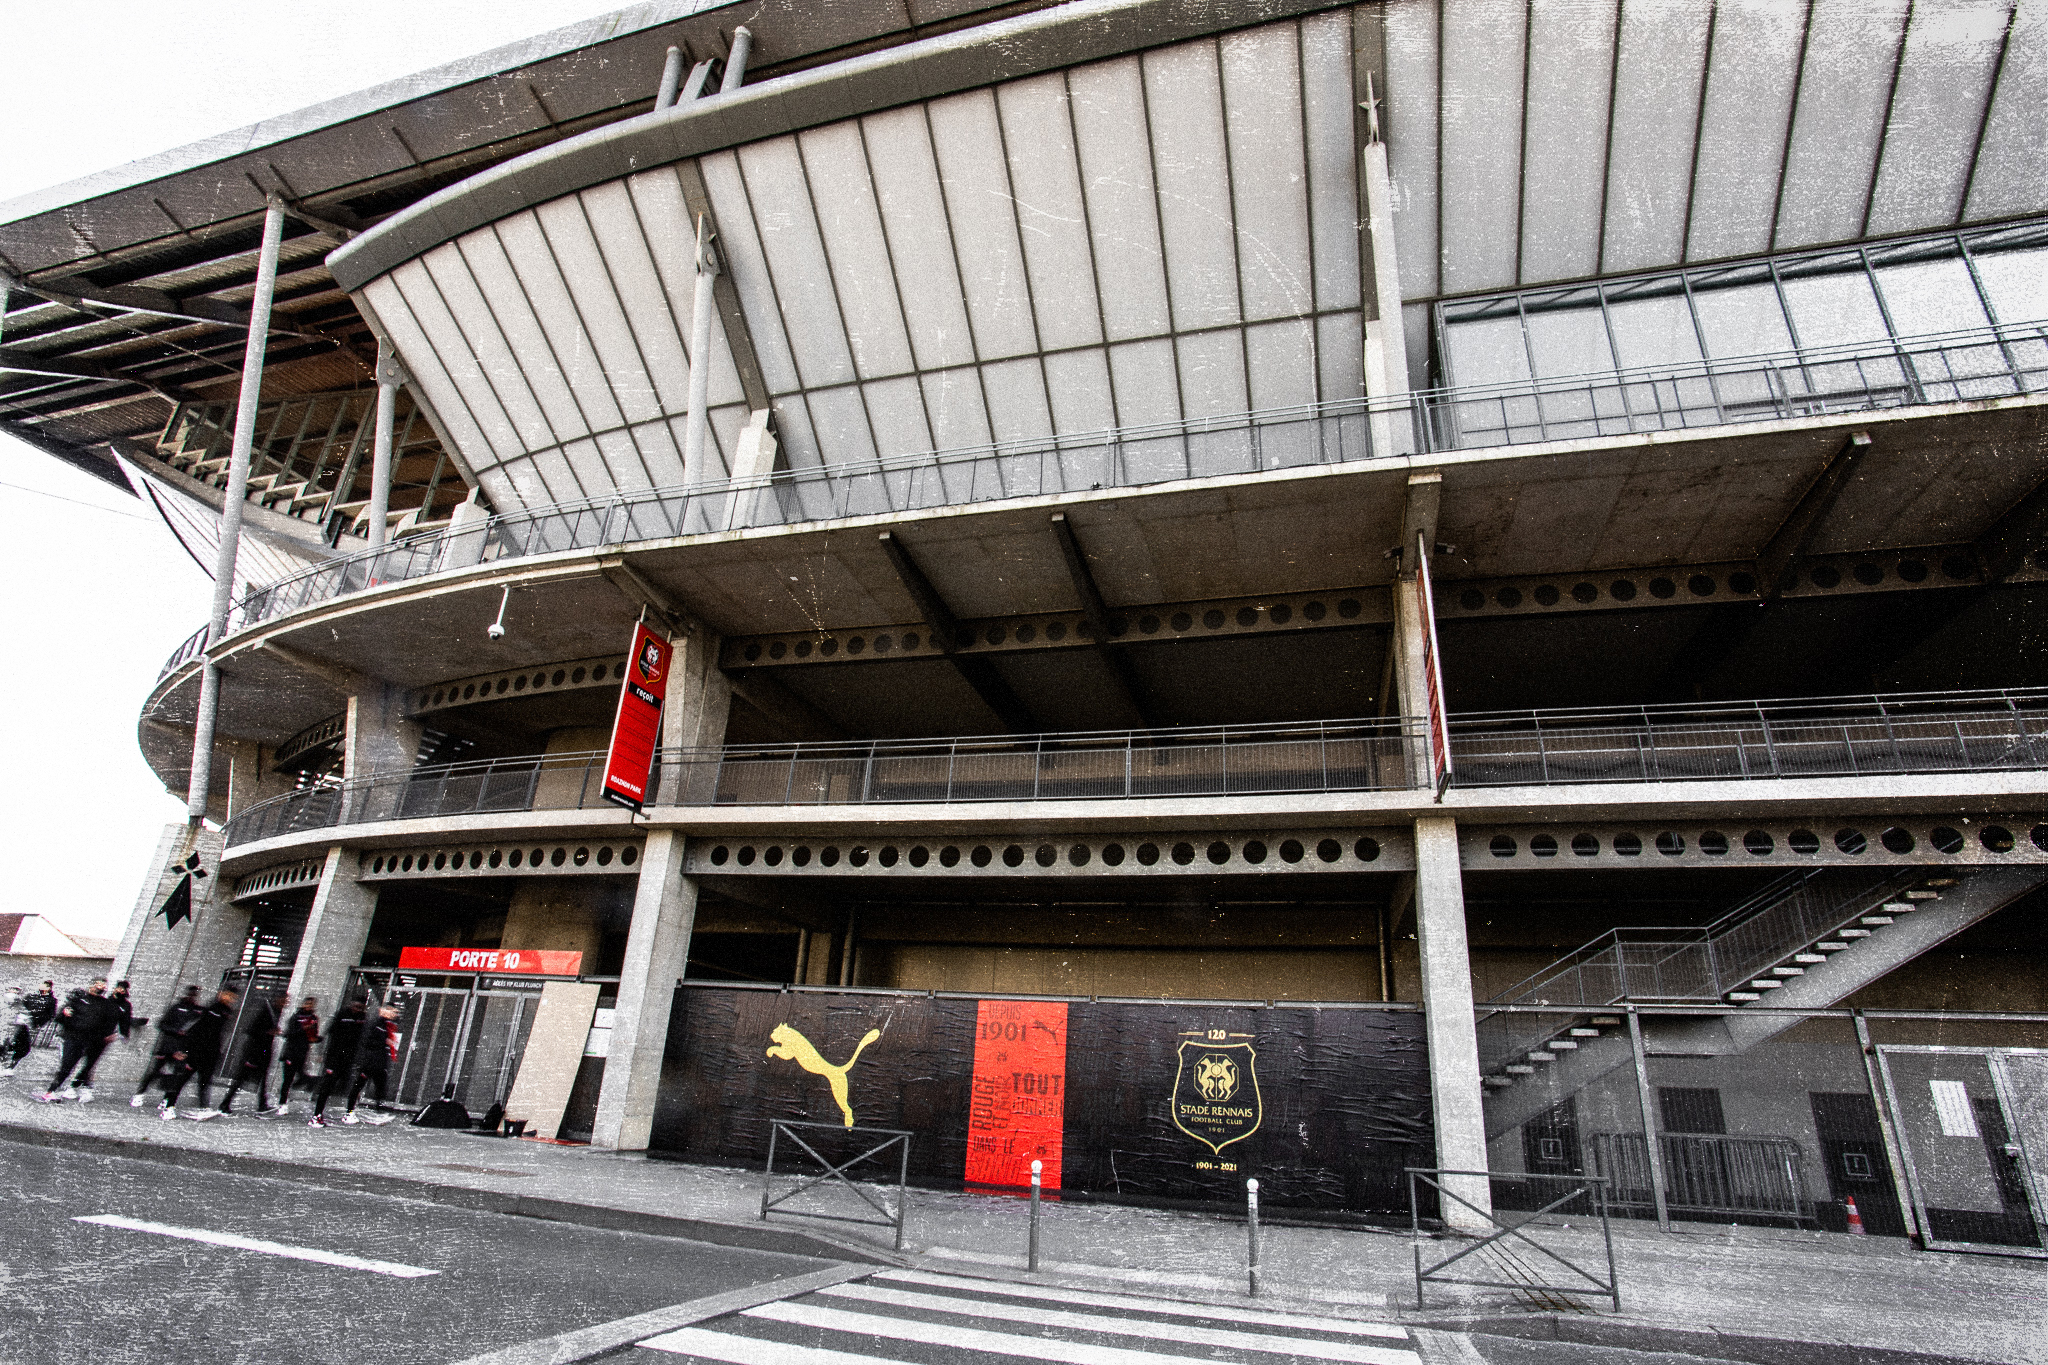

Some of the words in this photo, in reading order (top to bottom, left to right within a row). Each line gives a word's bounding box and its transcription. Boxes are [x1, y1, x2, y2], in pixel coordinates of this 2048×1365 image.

[636, 686, 654, 703] reçoit
[629, 783, 642, 795] PARK
[449, 950, 500, 968] PORTE
[503, 952, 520, 969] 10
[988, 1004, 1021, 1021] DEPUIS
[980, 1021, 1027, 1042] 1901
[1207, 1029, 1226, 1040] 120
[1011, 1072, 1062, 1096] TOUT
[972, 1075, 995, 1131] ROUGE
[1180, 1104, 1210, 1116] STADE
[1211, 1106, 1253, 1118] RENNAIS
[992, 1115, 1009, 1130] ET
[1191, 1116, 1222, 1124] FOOTBALL
[973, 1135, 997, 1153] DANS
[1196, 1161, 1213, 1170] 1901
[1220, 1162, 1237, 1171] 2021
